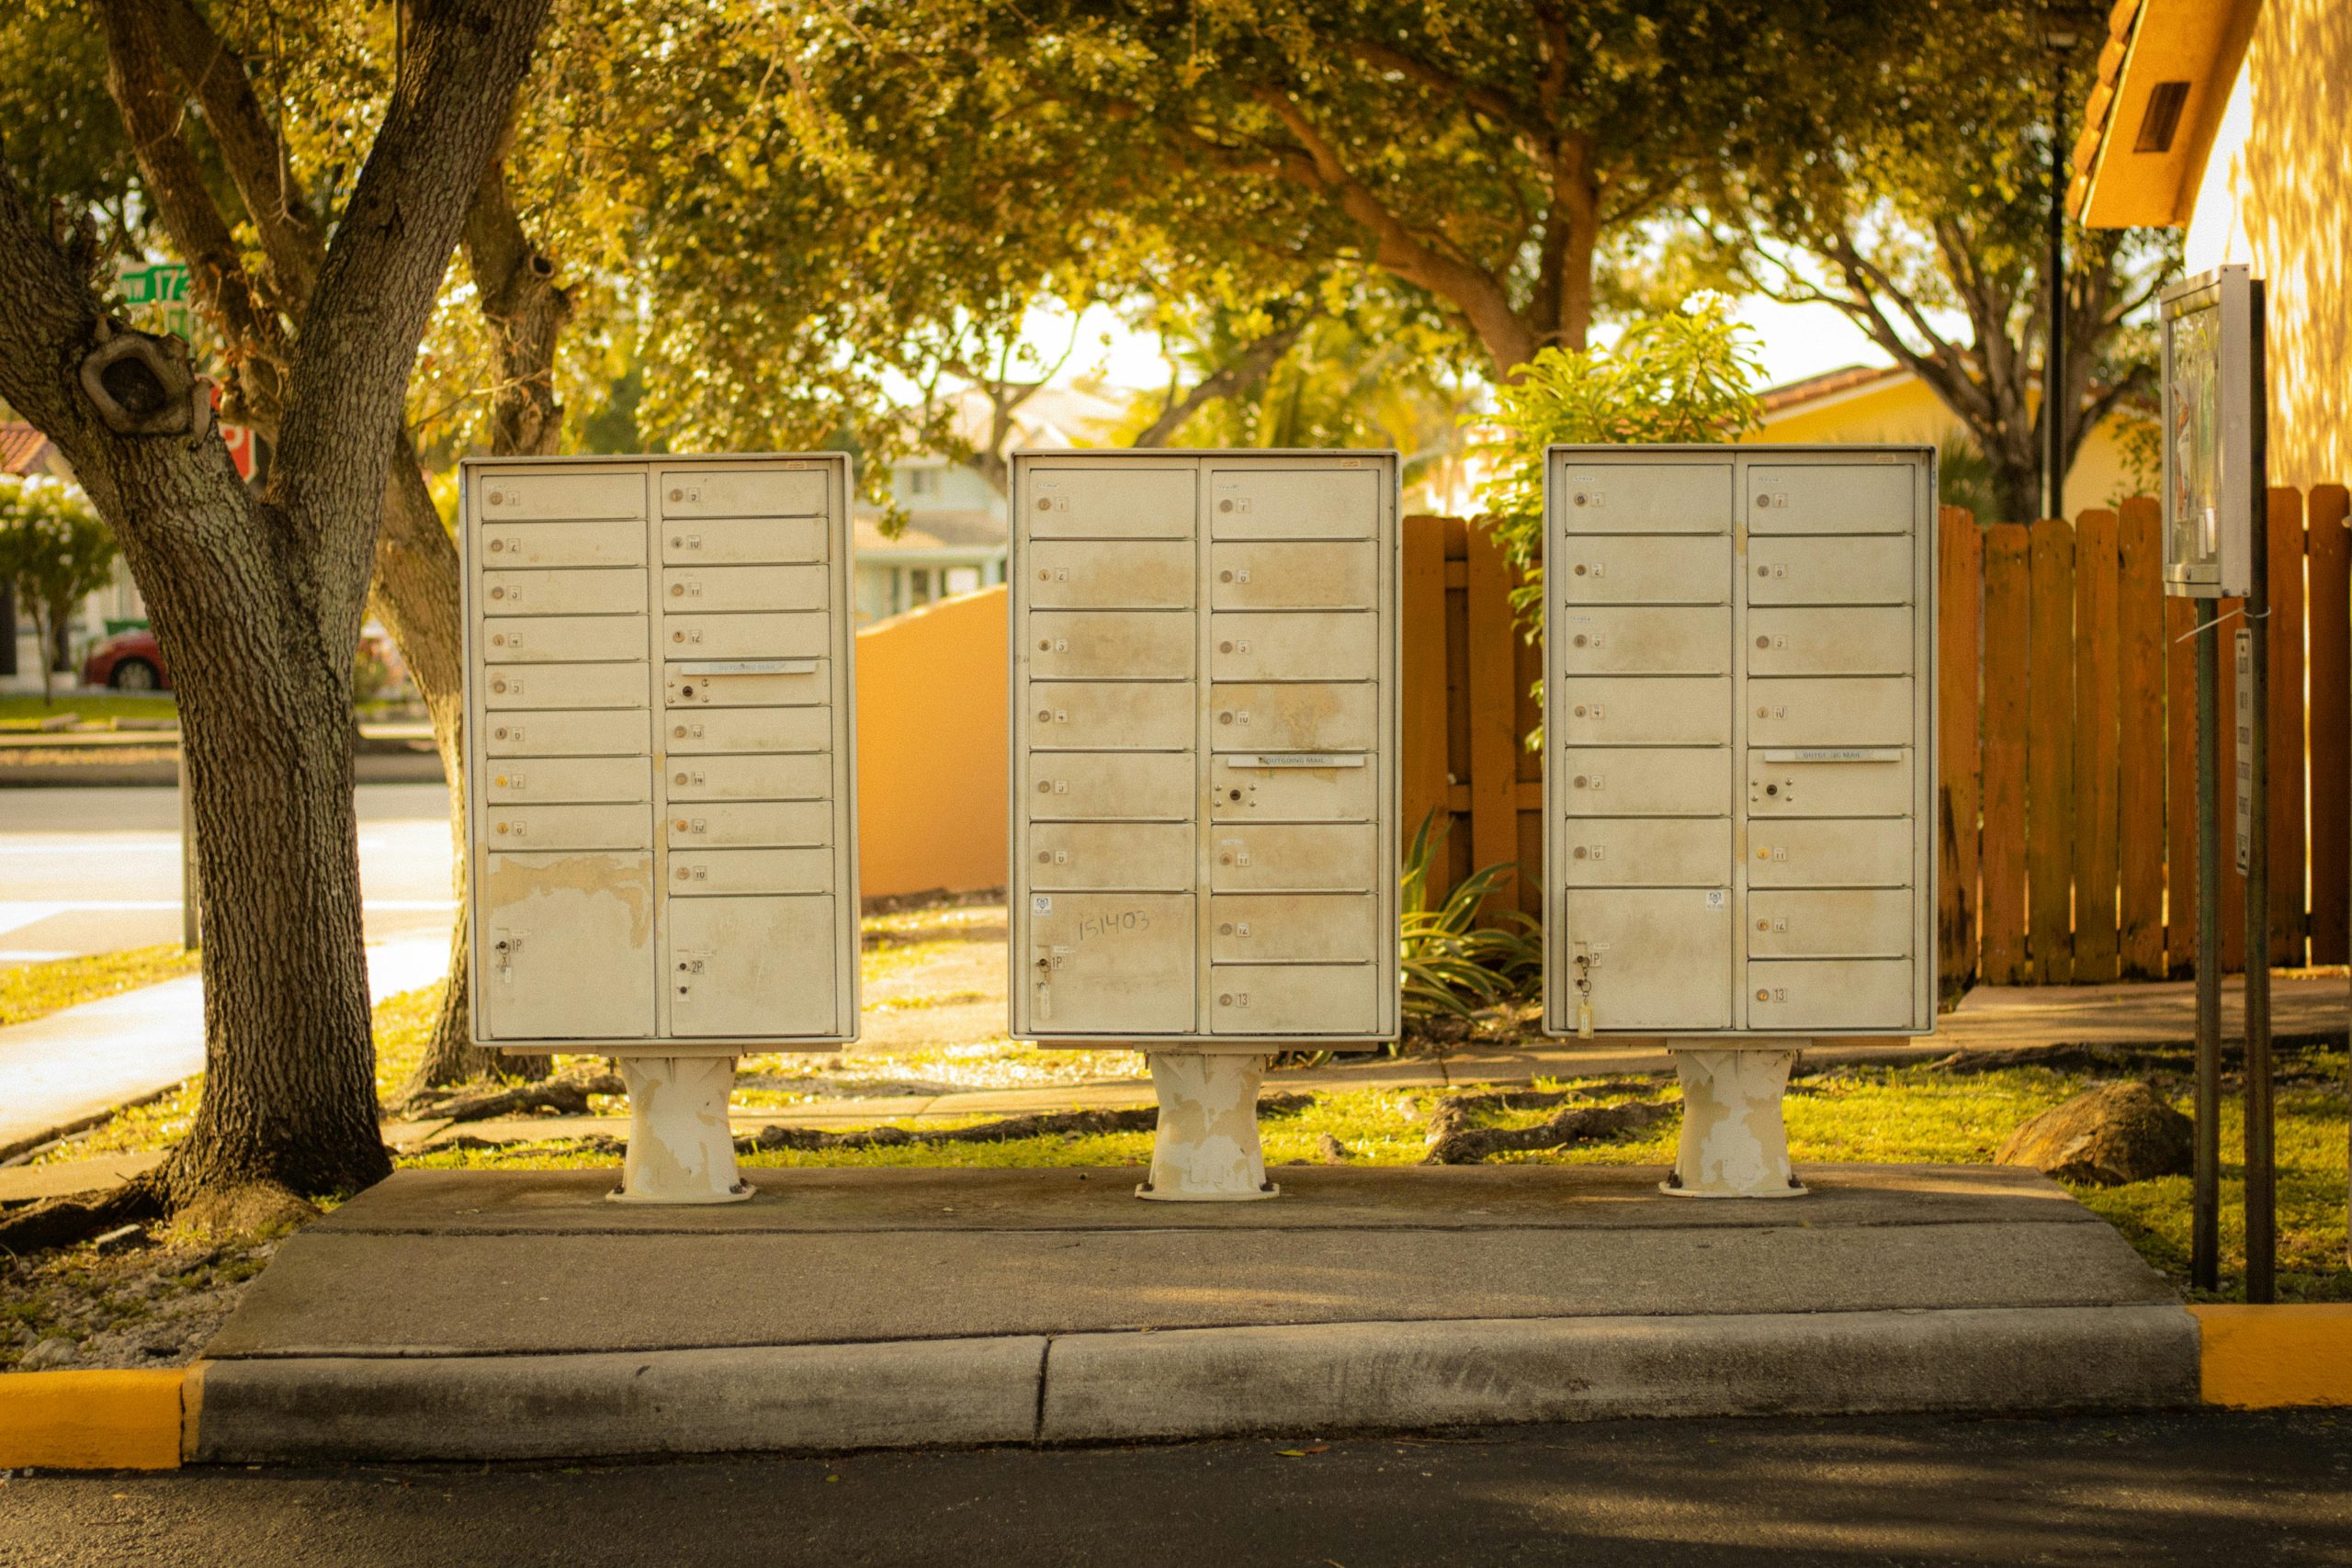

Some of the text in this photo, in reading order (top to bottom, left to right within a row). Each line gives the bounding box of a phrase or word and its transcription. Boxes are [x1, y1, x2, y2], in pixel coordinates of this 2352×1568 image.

[1080, 910, 1149, 941] 151403
[692, 961, 703, 973] 2P
[1052, 956, 1063, 968] 1P
[1238, 993, 1248, 1005] 13
[1774, 988, 1784, 1000] 13
